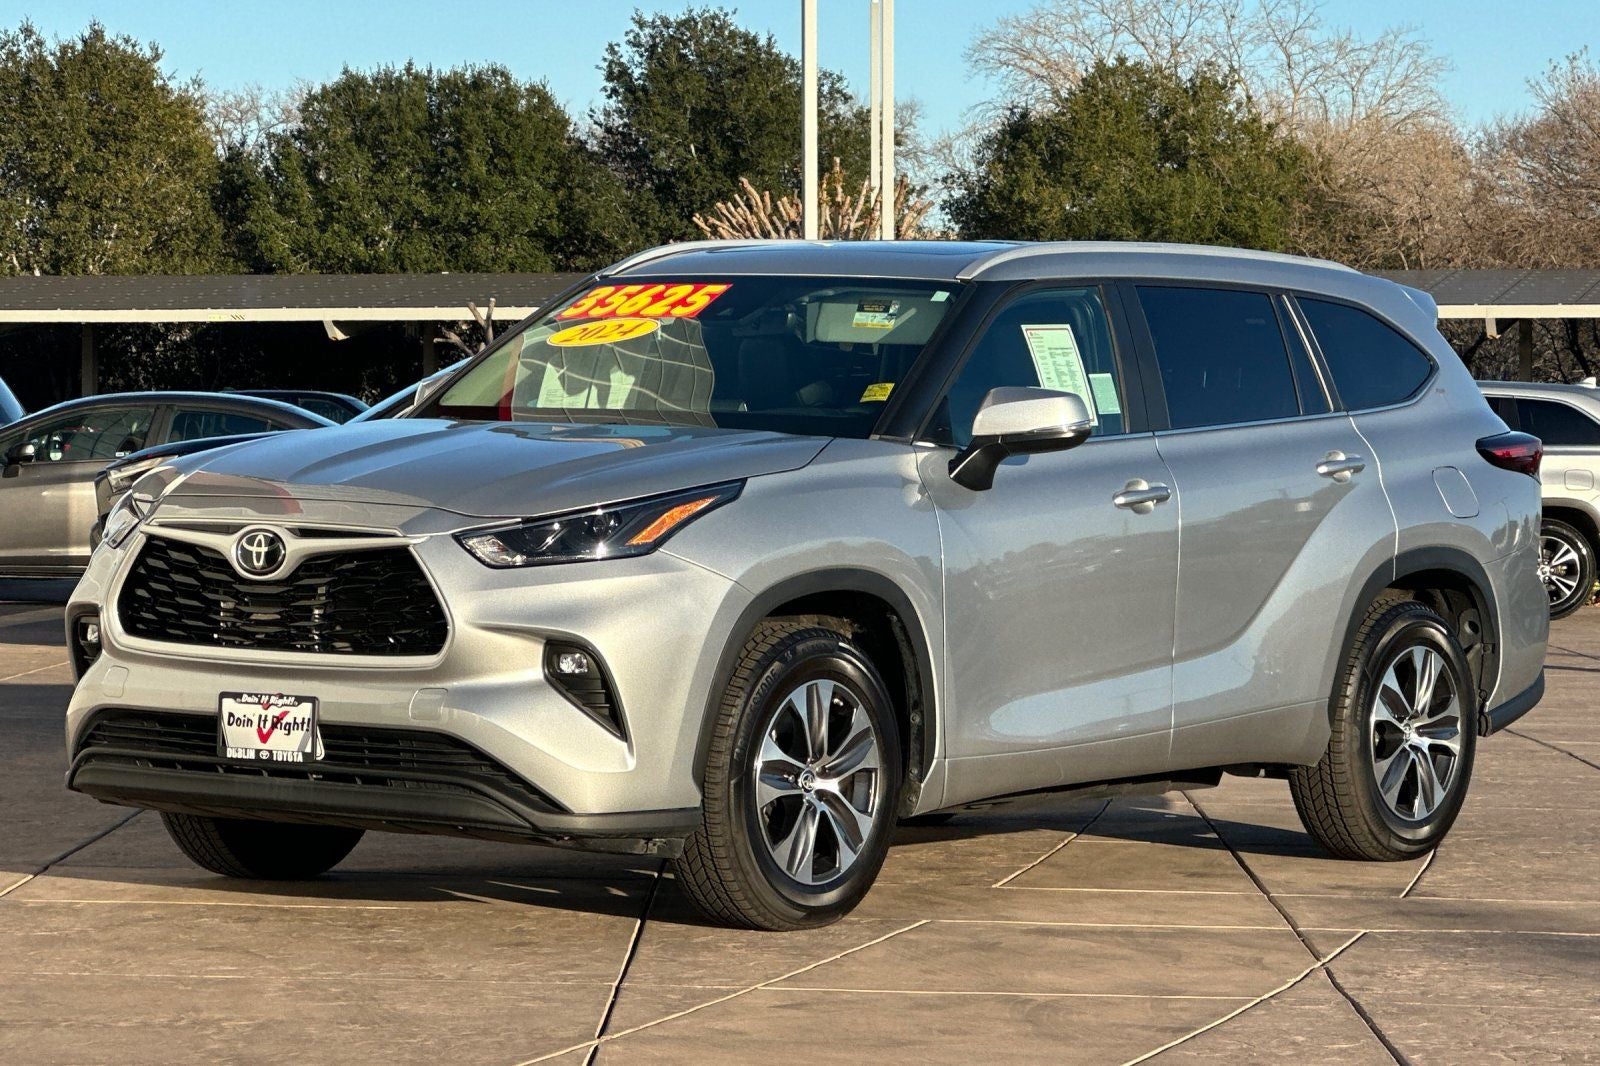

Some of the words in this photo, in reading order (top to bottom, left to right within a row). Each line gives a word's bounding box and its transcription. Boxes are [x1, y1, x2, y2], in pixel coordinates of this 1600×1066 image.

[560, 284, 729, 317] 35625
[559, 321, 648, 343] 2024
[227, 711, 255, 728] Doin'
[257, 714, 268, 729] It
[272, 715, 311, 736] Right!
[226, 747, 256, 760] DUBLIN
[272, 750, 303, 762] TOYOTA
